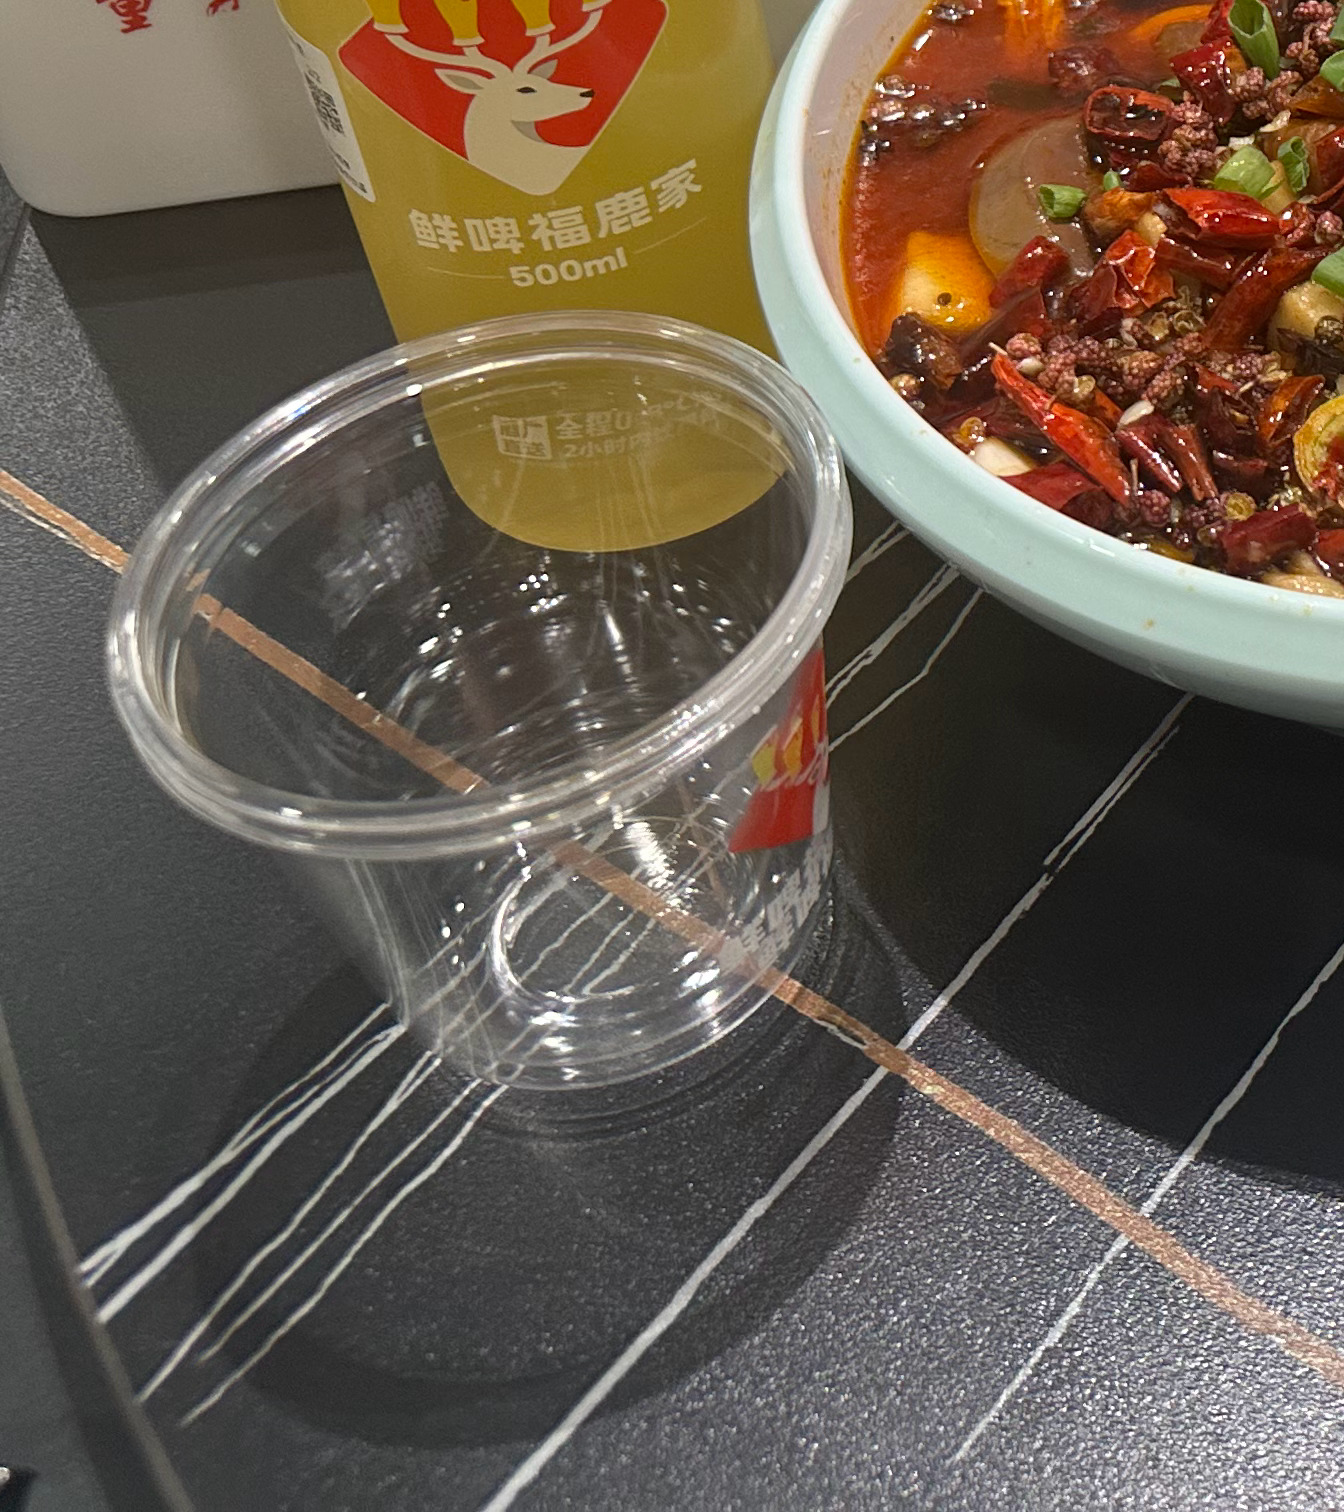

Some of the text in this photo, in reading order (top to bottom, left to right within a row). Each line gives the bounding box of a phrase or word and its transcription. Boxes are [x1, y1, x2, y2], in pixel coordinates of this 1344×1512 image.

[407, 158, 702, 255] 鲜啤福鹿家
[508, 245, 629, 288] 500ml
